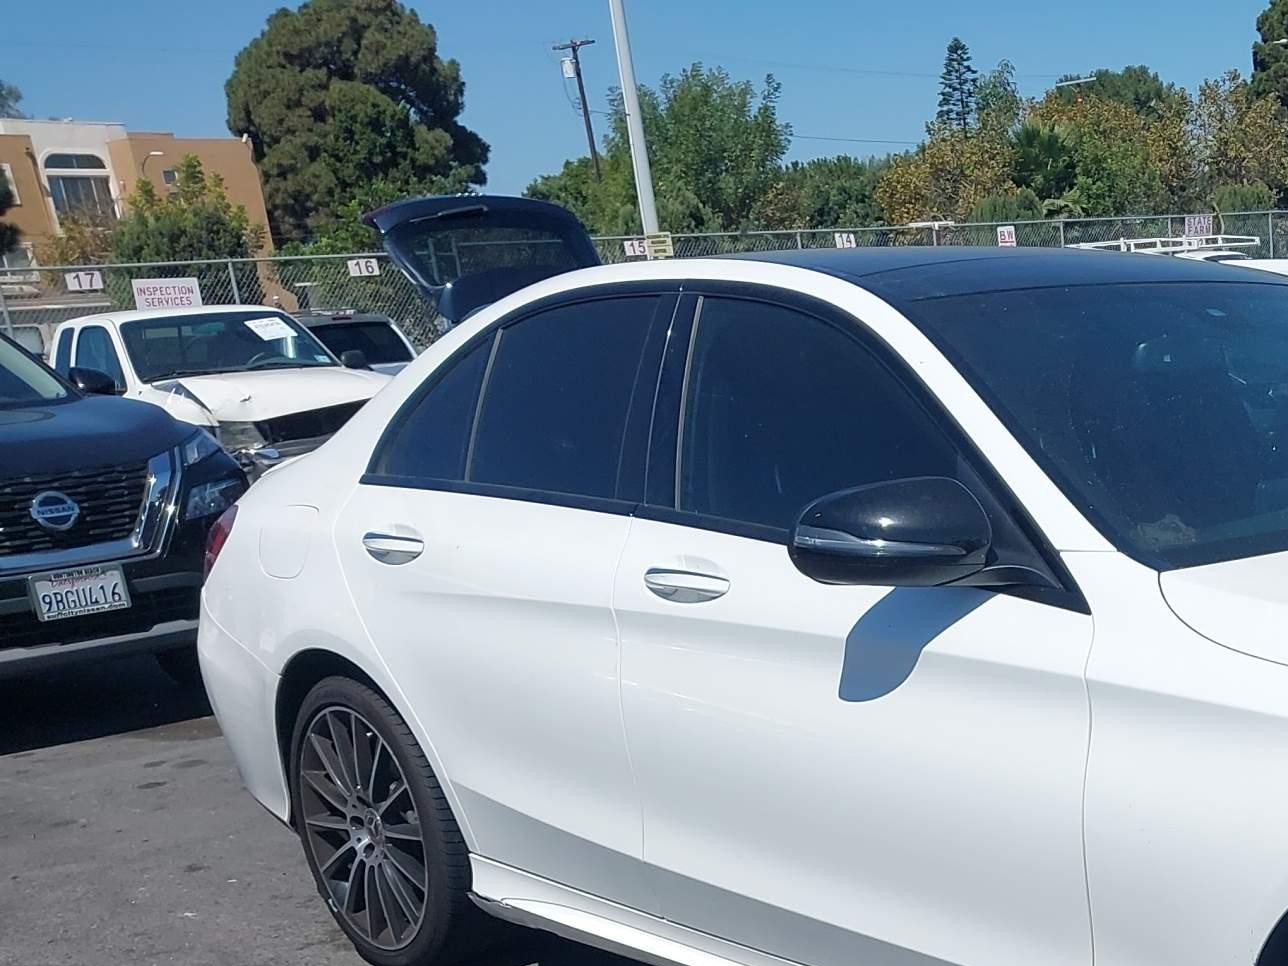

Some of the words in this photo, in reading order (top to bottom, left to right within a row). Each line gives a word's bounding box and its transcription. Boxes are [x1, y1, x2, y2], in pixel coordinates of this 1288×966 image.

[1187, 216, 1211, 225] STATE
[1188, 225, 1211, 234] FARM
[629, 240, 647, 255] 15
[838, 233, 853, 248] 14
[354, 260, 375, 275] 16
[73, 272, 95, 289] 17
[136, 285, 194, 297] INSPECTION
[145, 296, 193, 308] SERVICES
[36, 504, 76, 517] NISSAN
[41, 582, 122, 613] 9BGU416
